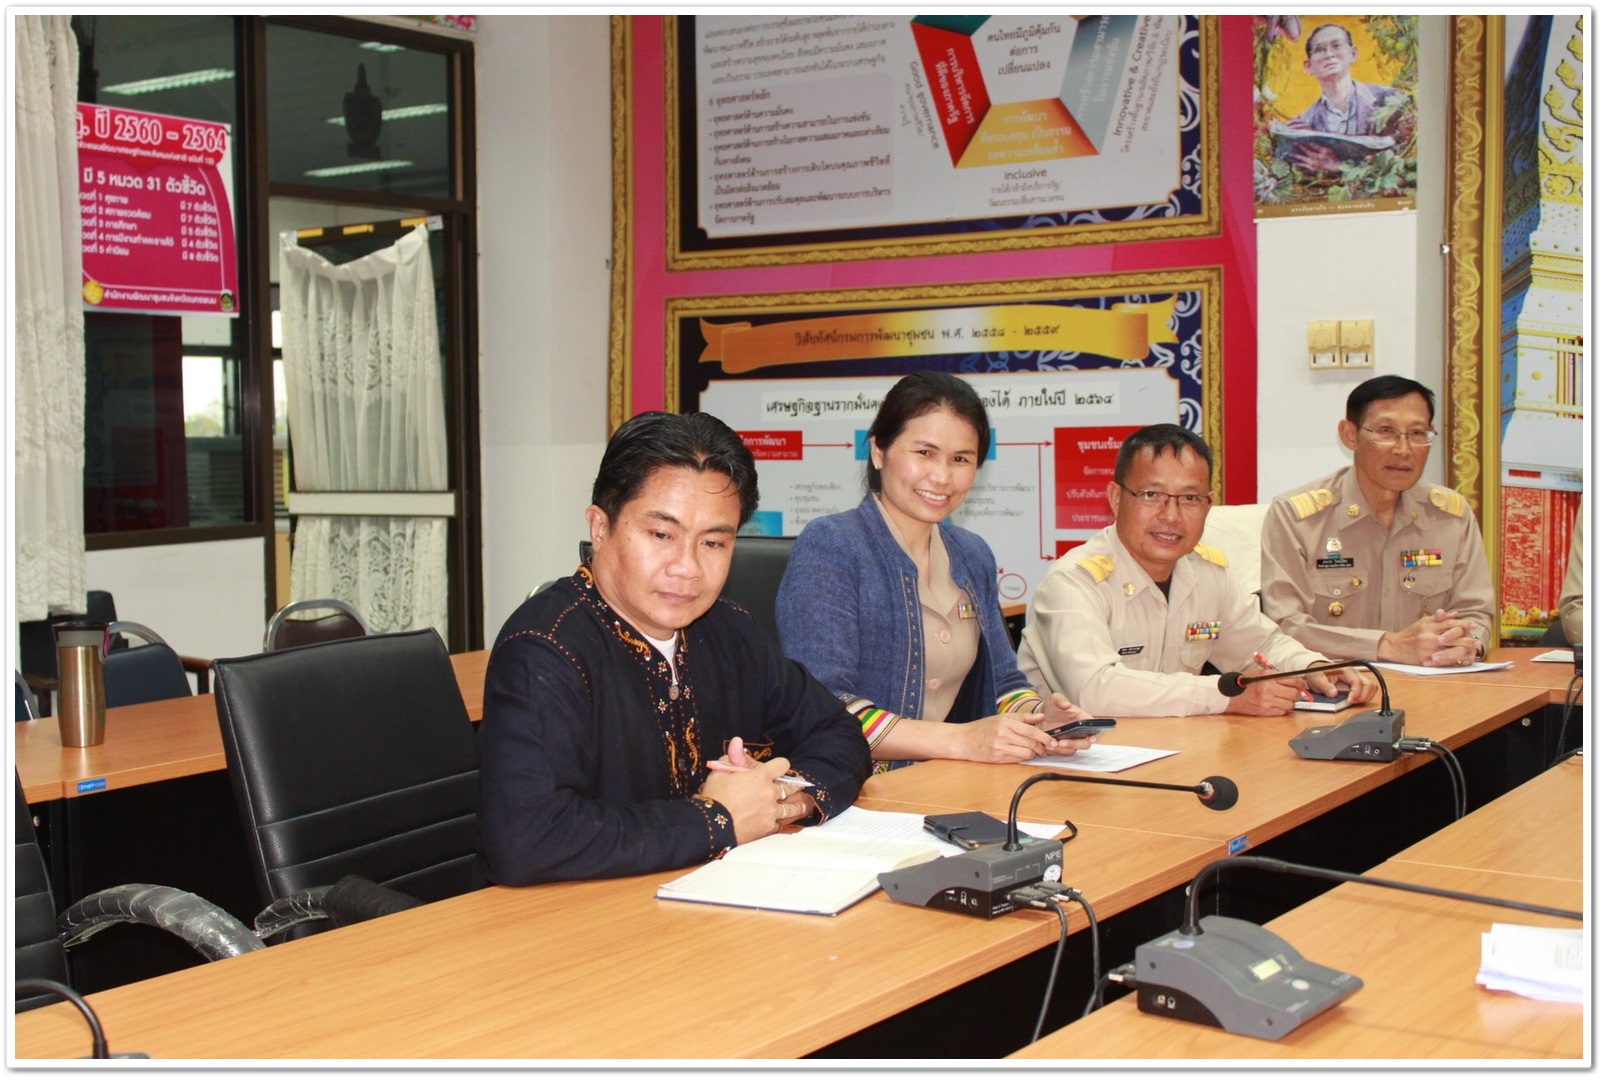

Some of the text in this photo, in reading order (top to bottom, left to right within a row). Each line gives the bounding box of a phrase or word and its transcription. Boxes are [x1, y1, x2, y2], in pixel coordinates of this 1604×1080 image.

[987, 22, 1061, 42] คนไทยมีภูมิคุ้มกัน
[1010, 45, 1038, 57] ต่อการ
[910, 61, 924, 89] Good
[998, 59, 1051, 76] เปลี่ยนแปลง
[1113, 15, 1151, 136] Innovative & Creative
[946, 48, 975, 124] การบริหารจัดการ
[95, 107, 110, 138] ปี
[114, 114, 163, 144] 2560
[182, 125, 226, 153] 2564
[916, 91, 939, 149] governance
[83, 167, 206, 196] มี 5 หมวด 31 ตัวชี้วัด
[1004, 168, 1047, 180] Inclusive
[794, 328, 935, 347] วิสัยทัศน์กรมการพัฒนาชุมชน
[941, 327, 964, 339] พ.ศ.
[1018, 388, 1066, 408] ภายในปี
[1074, 392, 1113, 405] ๒๕๖๔
[1045, 849, 1062, 863] NPE
